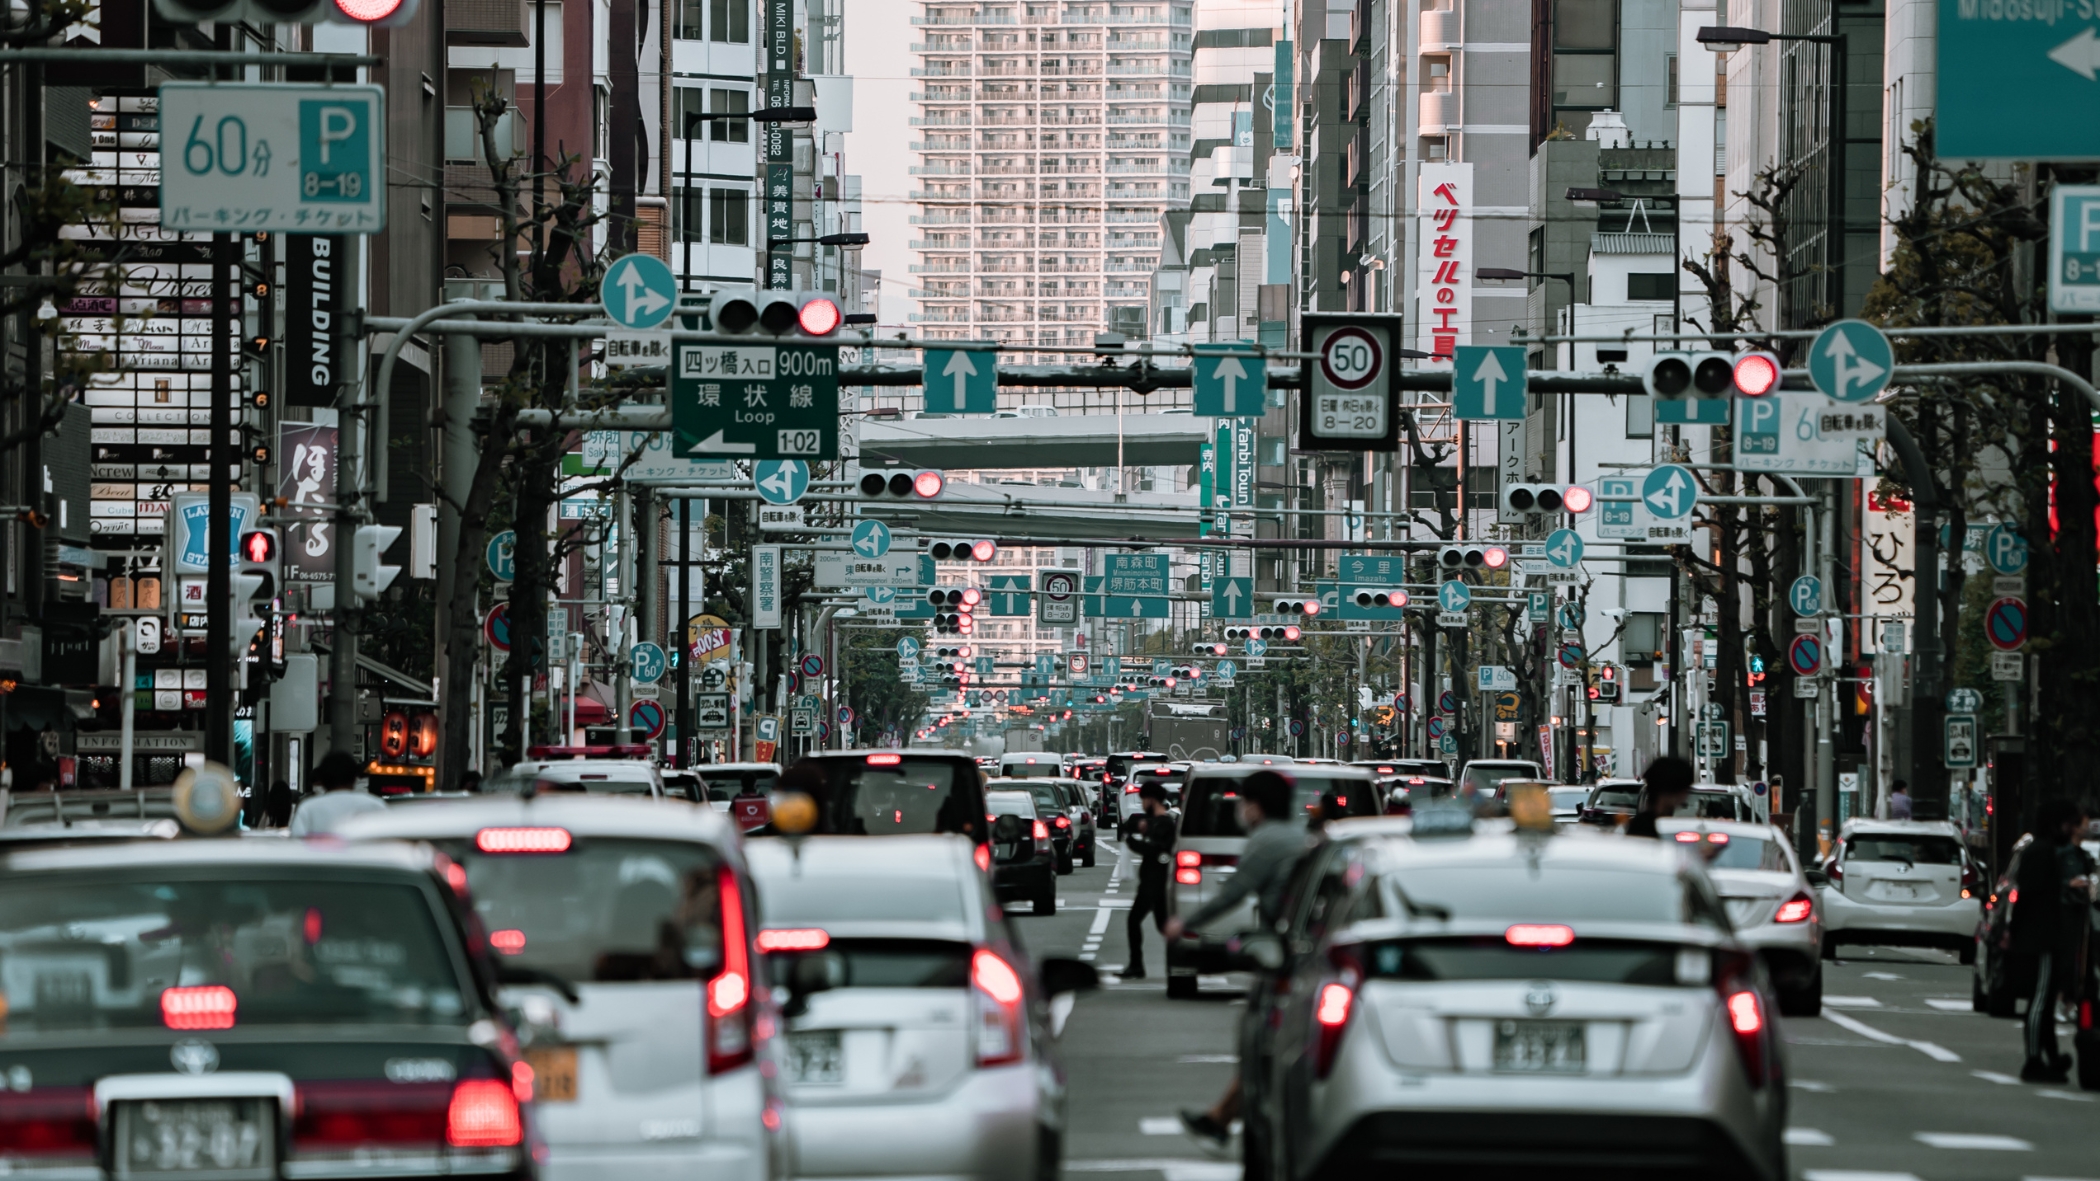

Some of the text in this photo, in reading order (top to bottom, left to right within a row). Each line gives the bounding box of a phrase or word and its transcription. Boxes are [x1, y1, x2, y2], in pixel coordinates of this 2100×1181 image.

[775, 2, 786, 57] MIKI BLD.
[319, 107, 356, 165] P
[312, 237, 331, 386] BUILDING
[255, 339, 267, 351] 7
[608, 340, 669, 356] 自転車を除く
[129, 354, 178, 367] Ariana
[685, 351, 832, 376] 四ツ橋入口 900m
[1334, 345, 1368, 371] 50
[256, 394, 267, 406] 6
[697, 384, 813, 407] 環状線
[735, 410, 775, 425] Loop
[1753, 401, 1773, 433] P
[1821, 413, 1884, 432] 自転車を除く
[780, 432, 818, 451] 1-02
[625, 466, 728, 476] パーキング・チケット
[1238, 428, 1252, 504] fanbi Town
[1611, 484, 1628, 508] P
[762, 511, 801, 522] 自転車を除く
[1648, 527, 1698, 539] 自転車を除く
[1997, 532, 2014, 566] P
[855, 563, 886, 573] 自転車を除く
[1116, 556, 1157, 569] 南森町
[1351, 560, 1391, 574] 今里
[759, 551, 775, 612] 南警察署
[1052, 581, 1068, 592] 50
[1110, 578, 1163, 591] 堺筋本町
[1354, 575, 1387, 583] Imazato
[186, 586, 201, 599] 酒
[1797, 584, 1811, 610] P
[1534, 594, 1545, 610] P
[635, 652, 650, 677] P
[1484, 669, 1491, 679] P
[83, 737, 188, 747] INFOMATION
